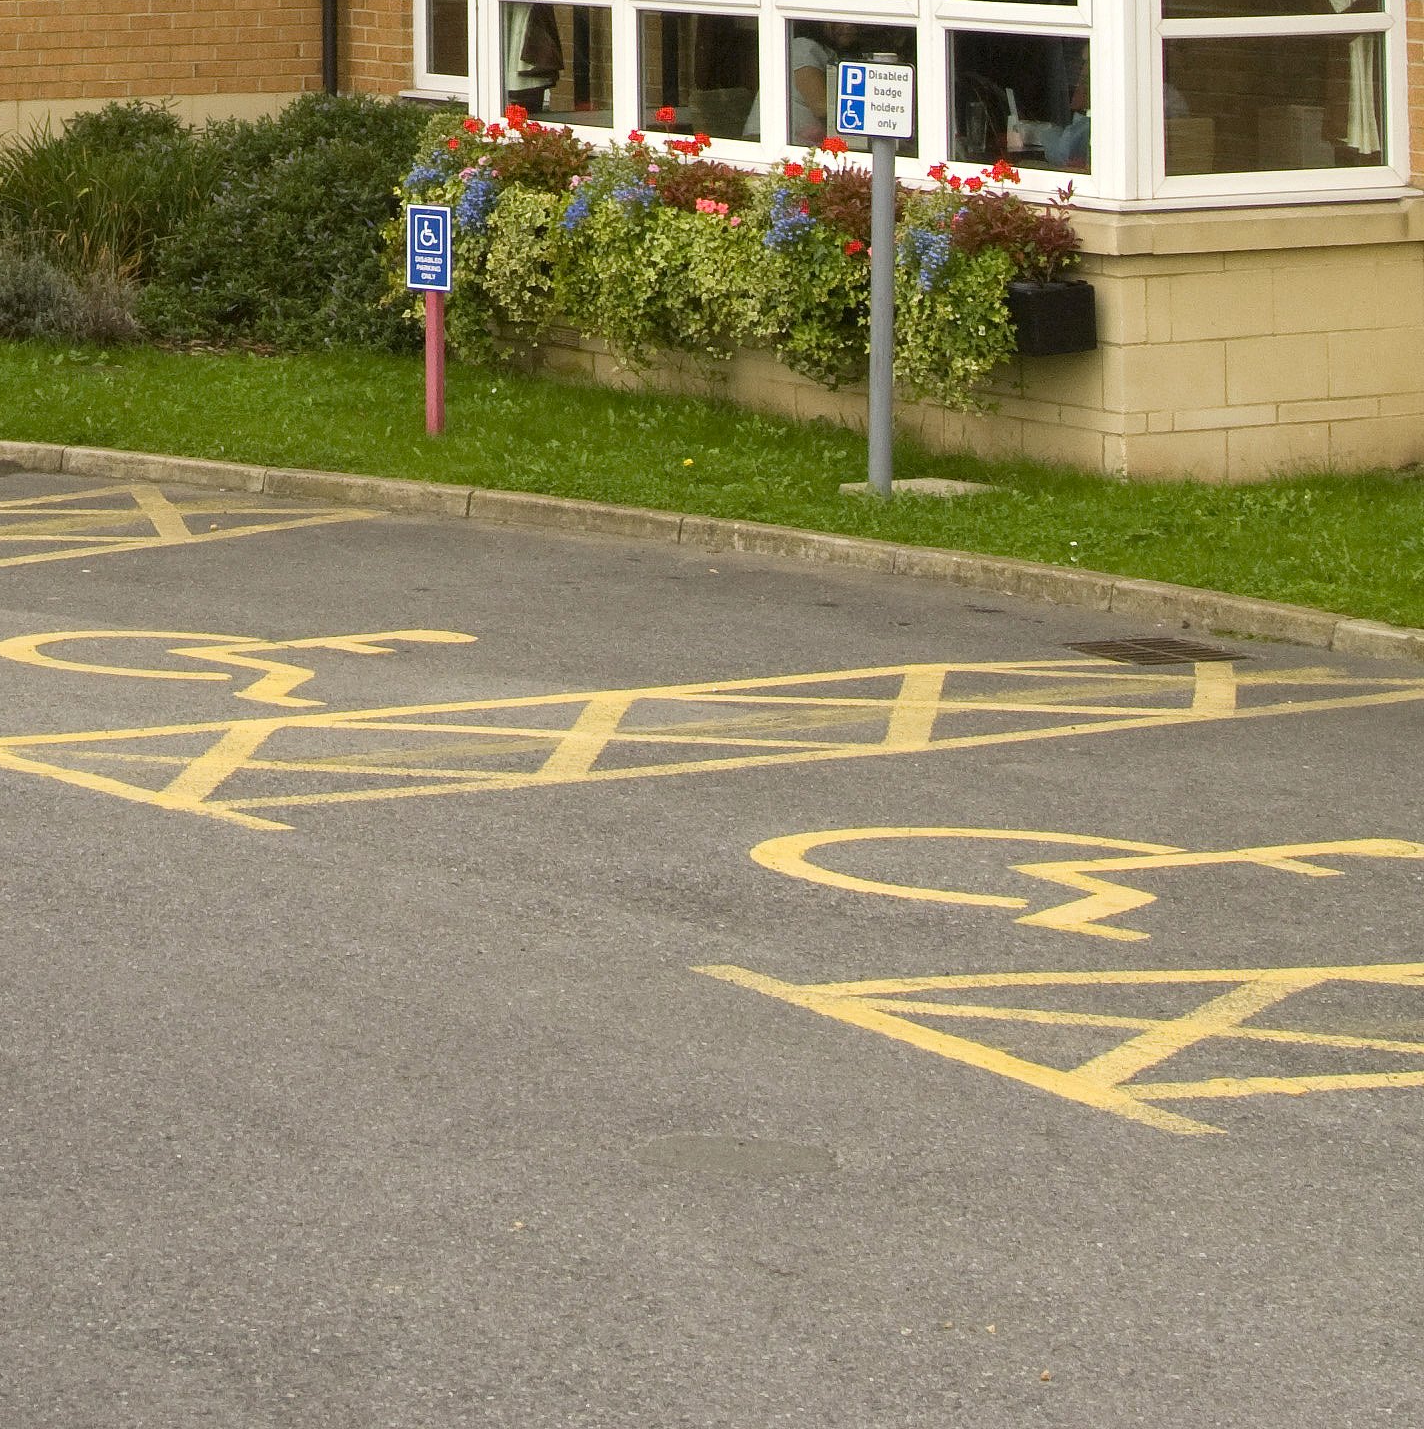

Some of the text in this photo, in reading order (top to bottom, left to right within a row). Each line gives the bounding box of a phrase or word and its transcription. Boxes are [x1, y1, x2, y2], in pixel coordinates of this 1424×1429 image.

[846, 68, 863, 94] P
[868, 70, 909, 82] Disabled
[874, 87, 902, 98] badge
[870, 102, 905, 113] holders
[878, 120, 897, 130] only
